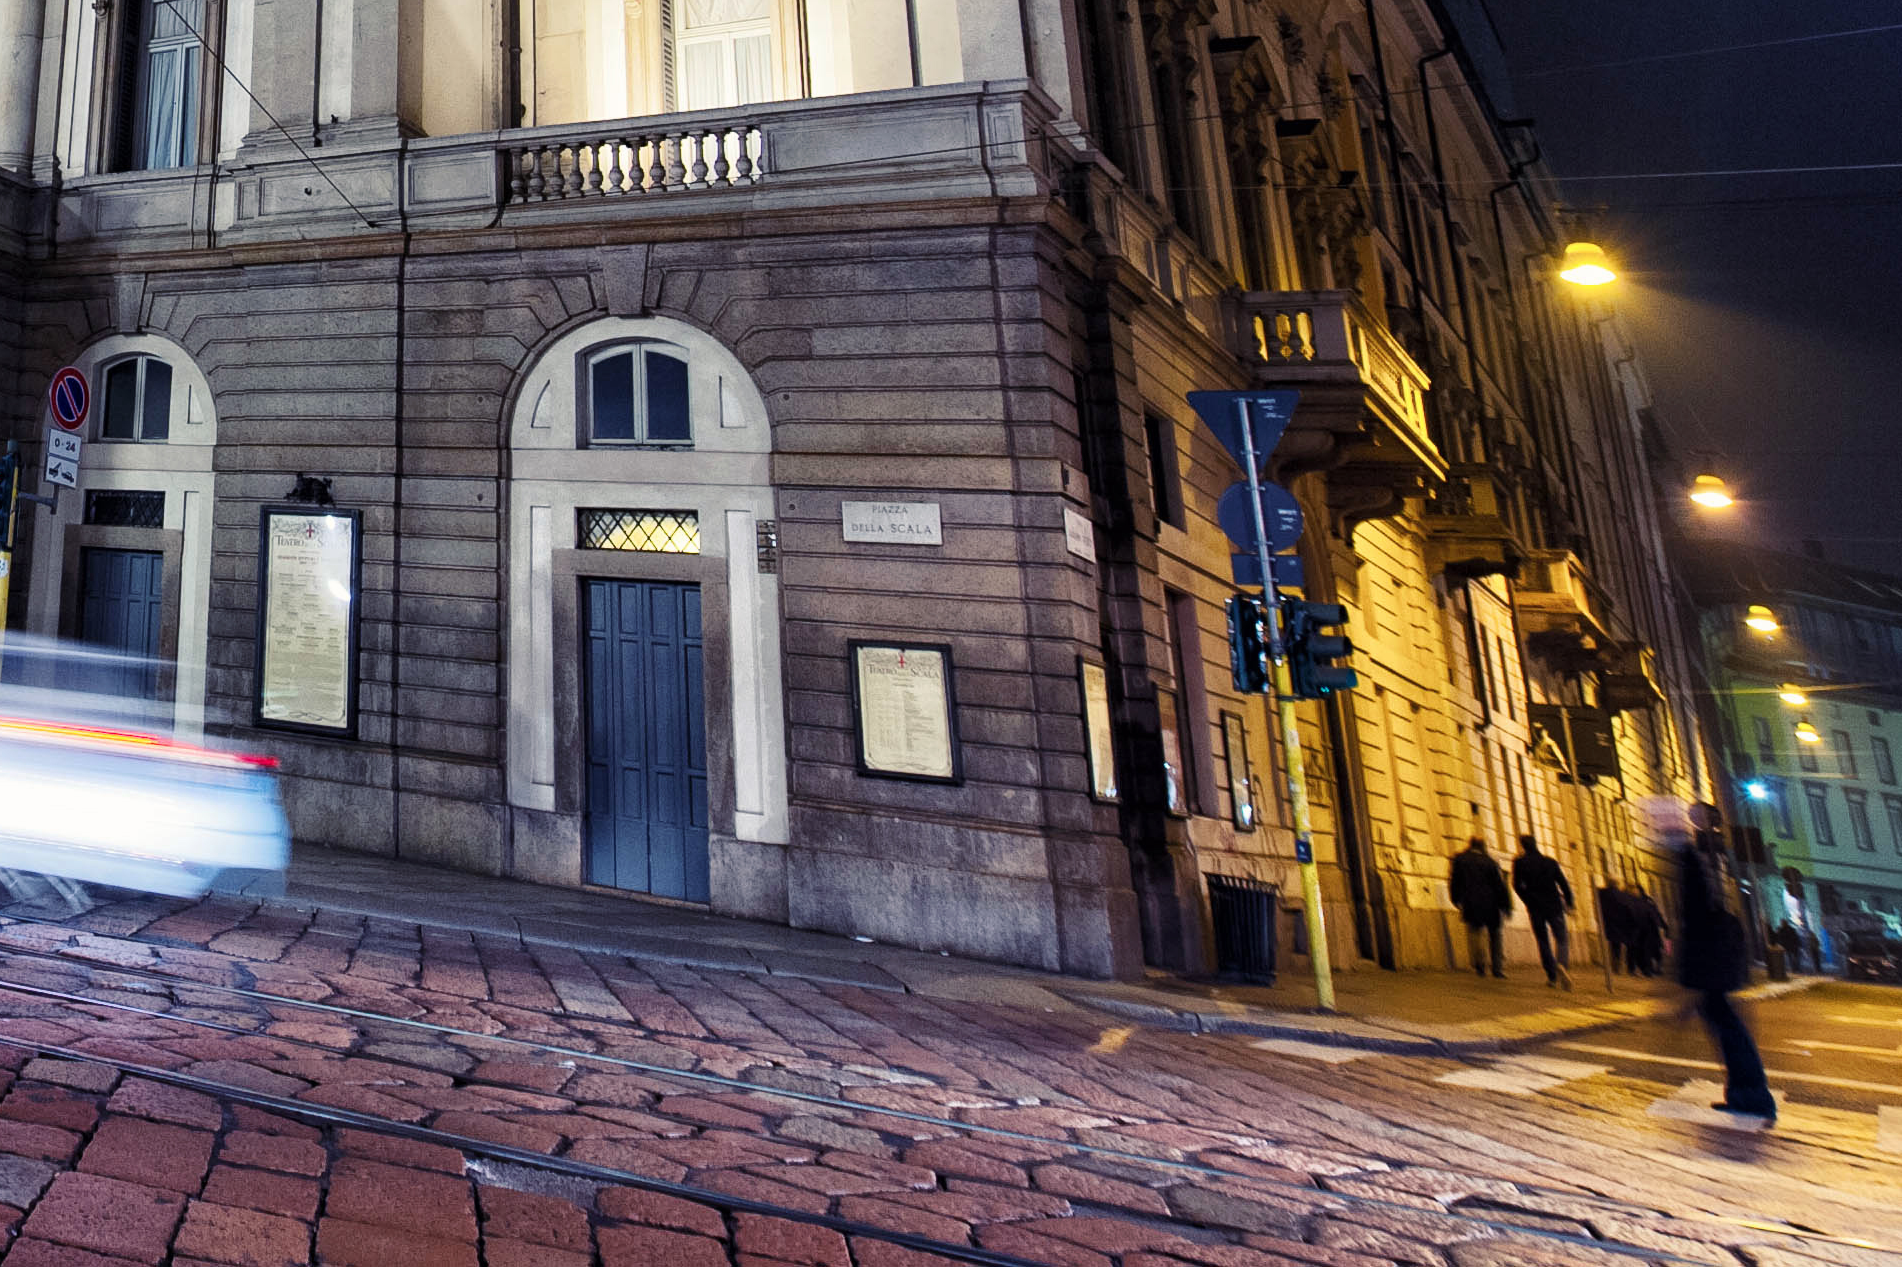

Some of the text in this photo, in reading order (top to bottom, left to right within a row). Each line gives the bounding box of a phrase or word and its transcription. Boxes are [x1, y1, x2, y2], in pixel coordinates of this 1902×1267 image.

[65, 440, 76, 452] 24
[871, 505, 908, 514] PIAZZA
[850, 523, 933, 534] DELLA SCALA
